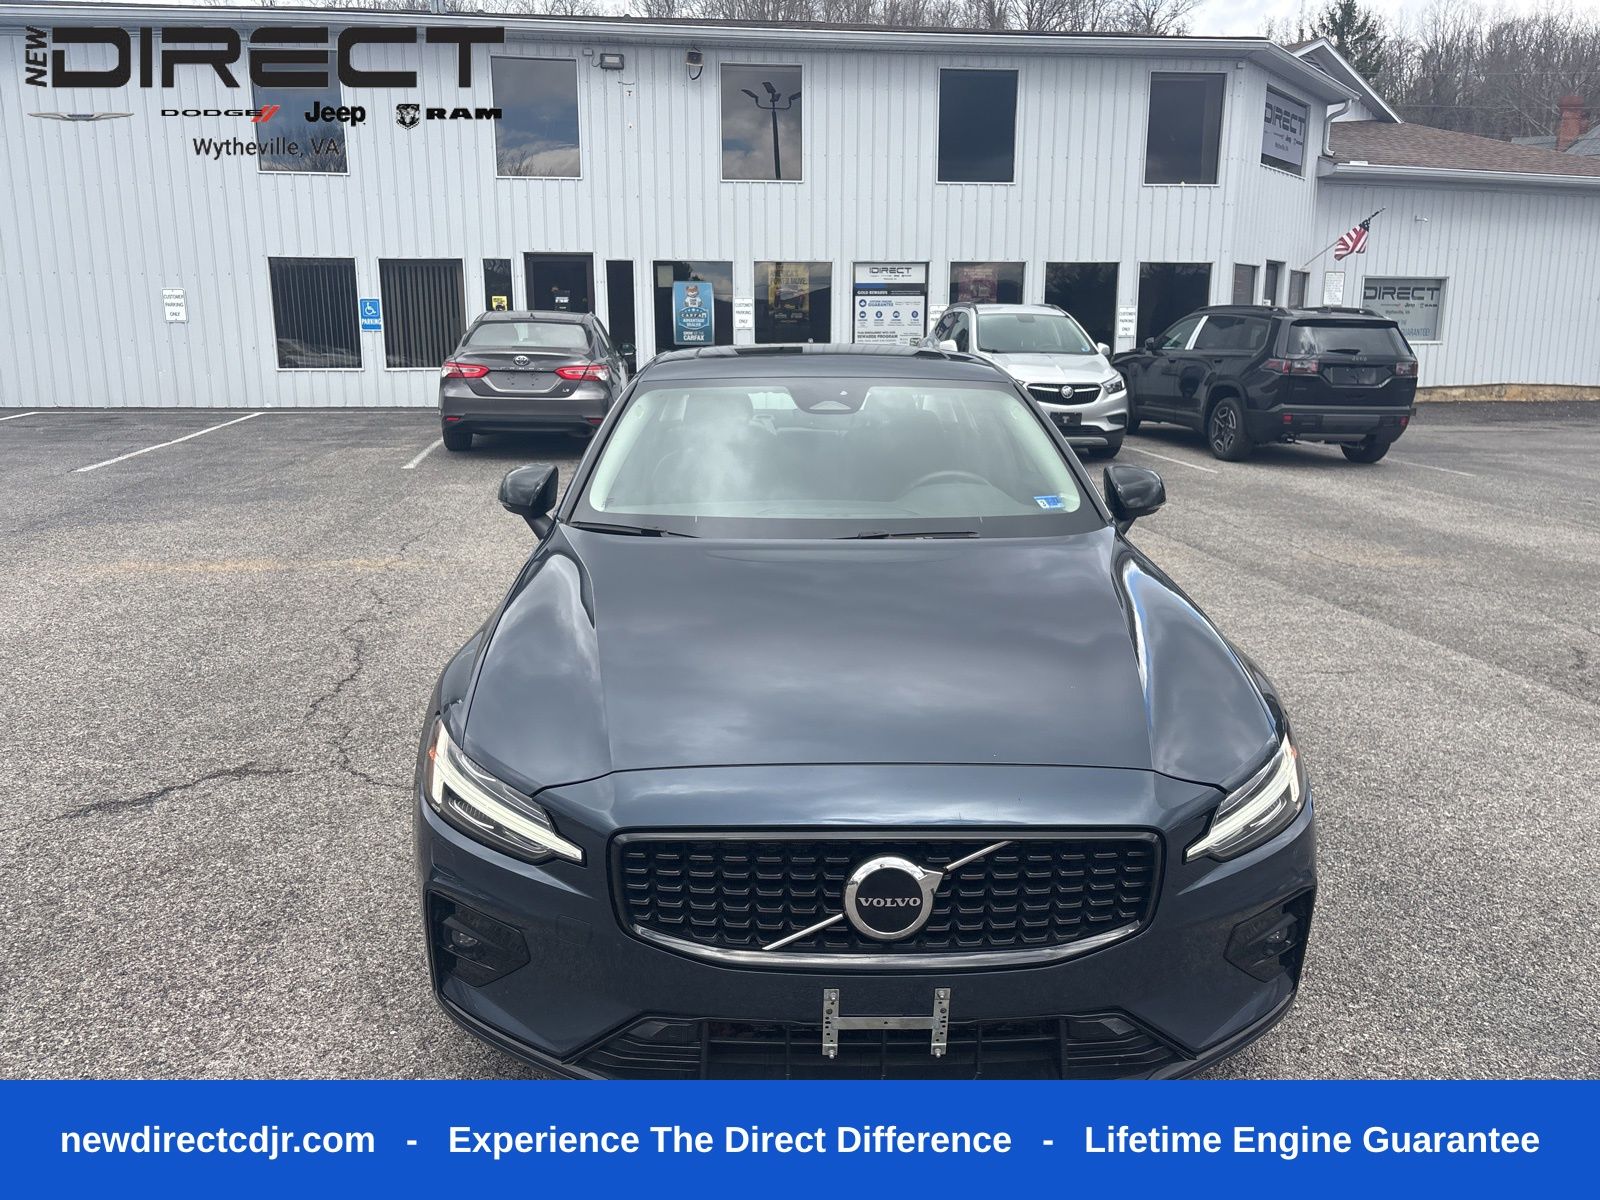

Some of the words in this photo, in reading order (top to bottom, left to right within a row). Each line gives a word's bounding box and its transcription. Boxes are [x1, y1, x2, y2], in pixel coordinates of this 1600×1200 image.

[1264, 102, 1305, 136] DIRECT
[1364, 286, 1440, 300] DIRECT
[858, 897, 921, 907] VOLVO
